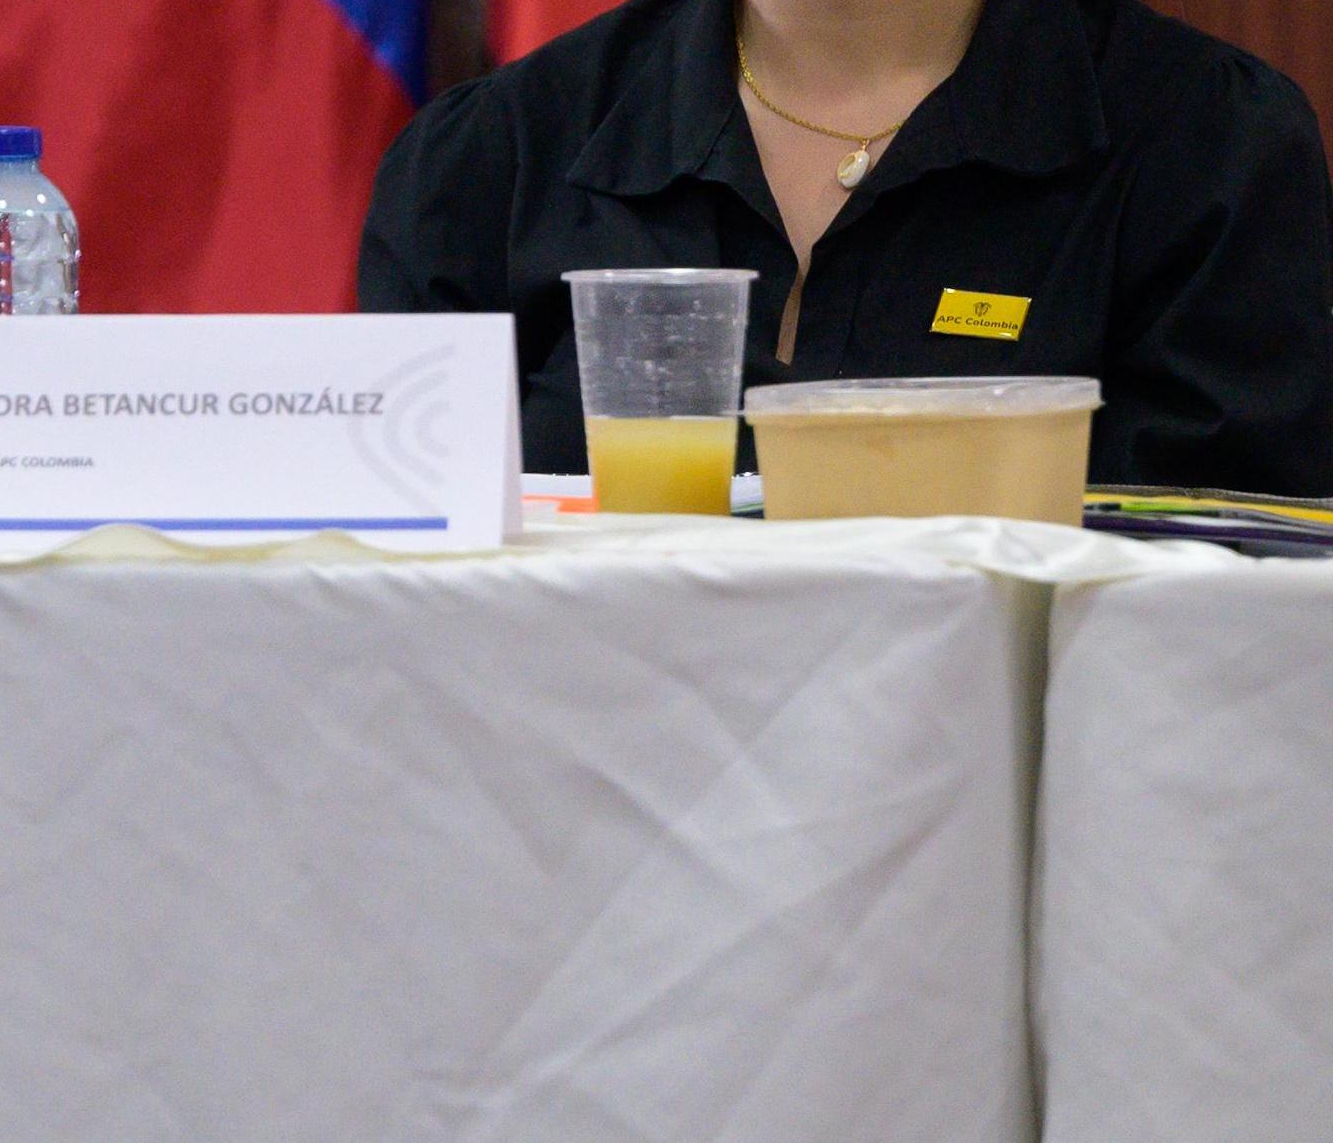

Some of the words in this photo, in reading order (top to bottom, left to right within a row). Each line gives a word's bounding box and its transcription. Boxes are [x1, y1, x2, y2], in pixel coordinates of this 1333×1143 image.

[937, 315, 962, 324] APC
[965, 318, 1019, 330] Colombia
[63, 393, 219, 416] BETANCUR
[228, 387, 384, 416] GONZÁLEZ
[21, 456, 94, 468] COLOMBIA
